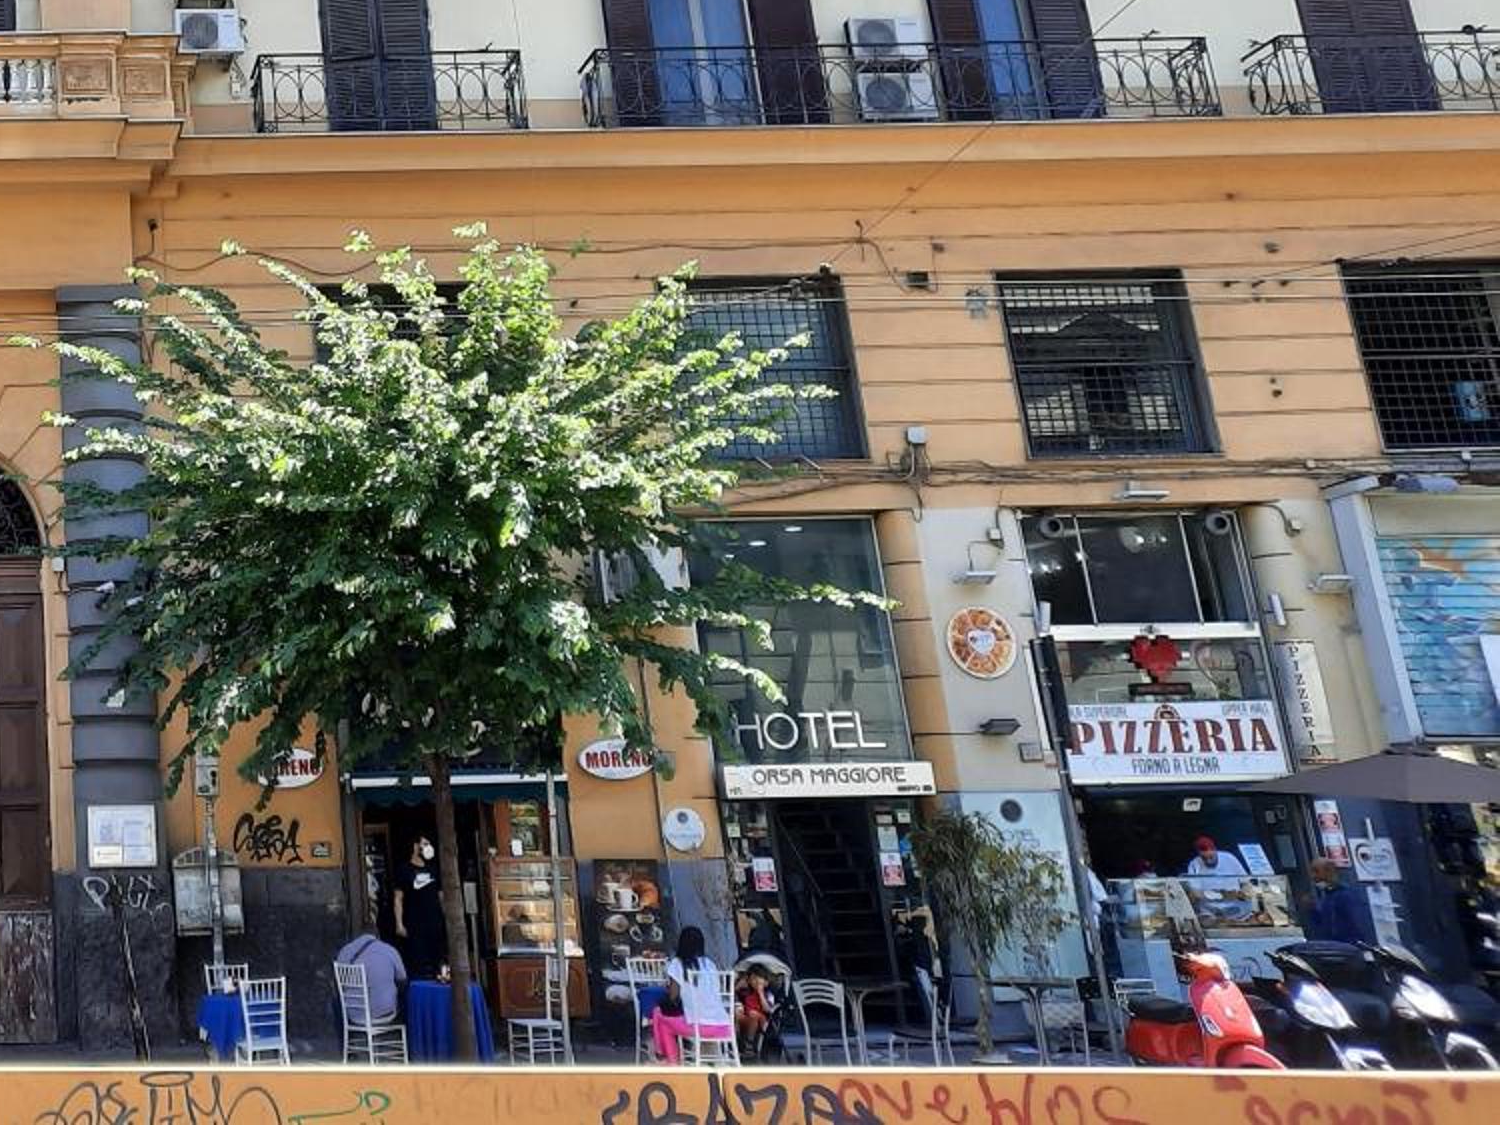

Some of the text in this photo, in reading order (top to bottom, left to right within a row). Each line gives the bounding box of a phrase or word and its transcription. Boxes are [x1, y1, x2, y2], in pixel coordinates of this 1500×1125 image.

[1289, 646, 1321, 755] PIZZERIA
[732, 710, 886, 750] HOTEL
[1066, 718, 1278, 755] PIZZERIA
[753, 766, 906, 785] ORSA MAGGIORE
[1131, 758, 1170, 774] FORNO
[1183, 756, 1220, 774] LEGNA
